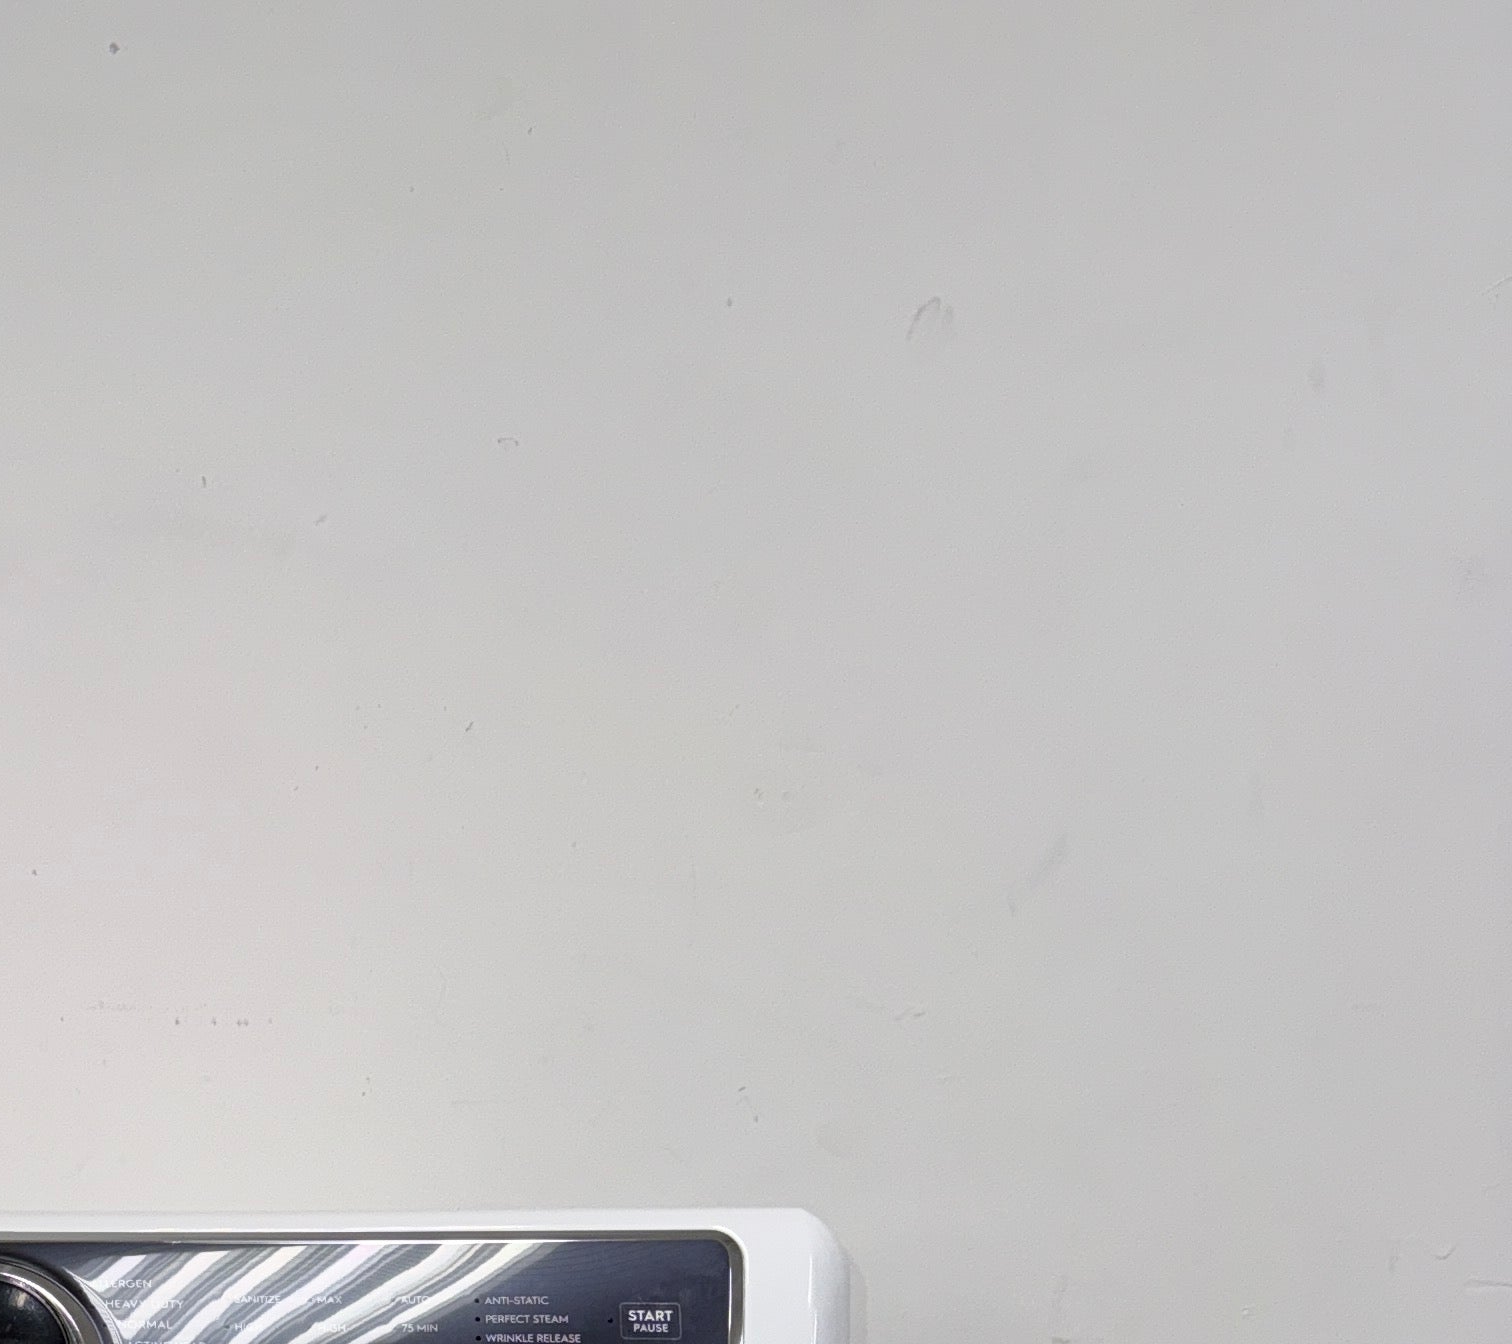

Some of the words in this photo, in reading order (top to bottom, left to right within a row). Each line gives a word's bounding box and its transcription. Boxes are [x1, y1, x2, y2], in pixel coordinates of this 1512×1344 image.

[484, 1296, 549, 1306] ANTI-STATIC
[486, 1313, 530, 1323] PERFECT
[533, 1314, 568, 1323] STEAM
[629, 1310, 673, 1321] START
[401, 1324, 414, 1332] 75
[417, 1324, 438, 1332] MIN
[634, 1323, 668, 1332] PAUSE
[485, 1334, 534, 1342] WRINKLE
[537, 1334, 581, 1343] RELEASE
